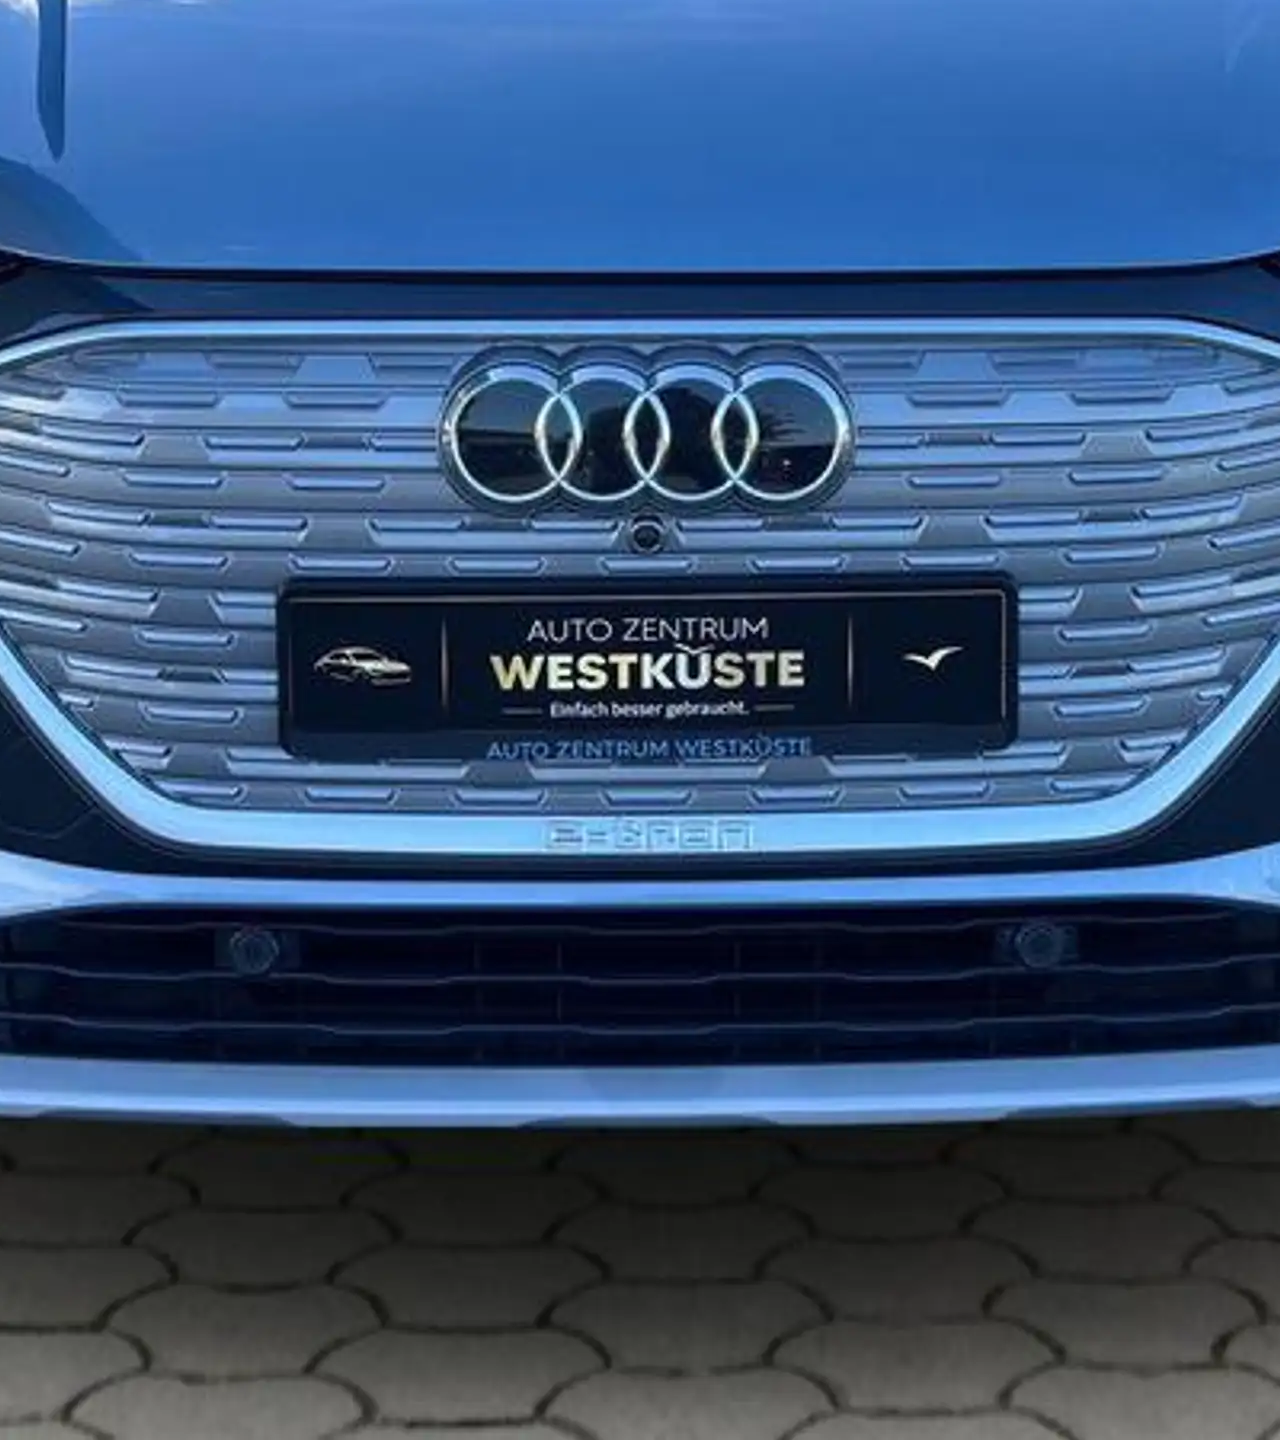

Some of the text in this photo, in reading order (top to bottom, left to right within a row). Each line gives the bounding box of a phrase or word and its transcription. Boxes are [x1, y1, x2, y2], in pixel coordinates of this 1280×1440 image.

[526, 616, 770, 642] AUTO ZENTRUM
[550, 700, 750, 720] Einfach besser gebraucht.
[486, 741, 549, 760] AUTO
[554, 739, 668, 759] ZENTRUM
